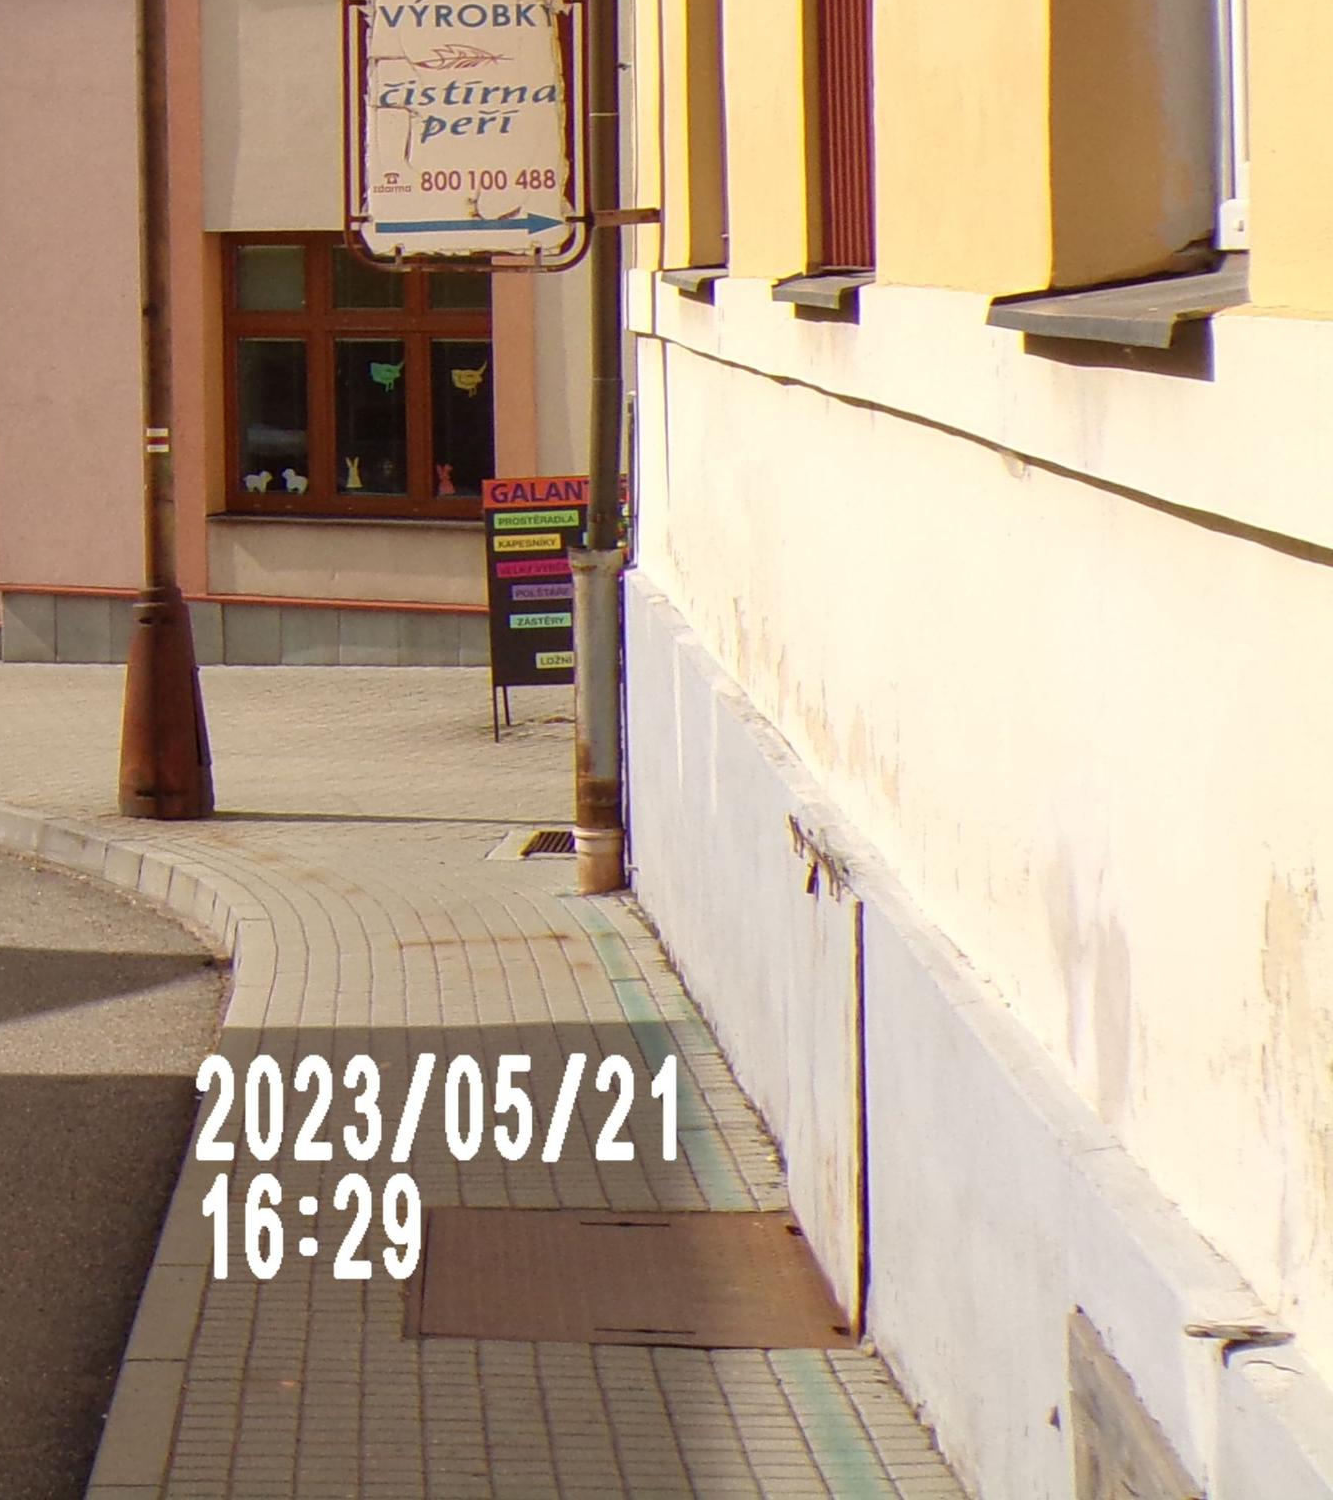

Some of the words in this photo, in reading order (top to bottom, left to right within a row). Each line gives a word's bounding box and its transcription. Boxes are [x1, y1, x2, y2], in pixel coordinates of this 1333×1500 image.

[379, 80, 557, 108] čistírna
[420, 109, 520, 144] peří
[420, 170, 462, 192] 800
[467, 169, 508, 191] 100
[515, 168, 557, 190] 488
[490, 480, 589, 504] GALAN
[498, 513, 575, 526] PROSTĚRADLA
[498, 536, 557, 549] KAPESNÍKY
[516, 615, 565, 627] ZÁSTĚRY
